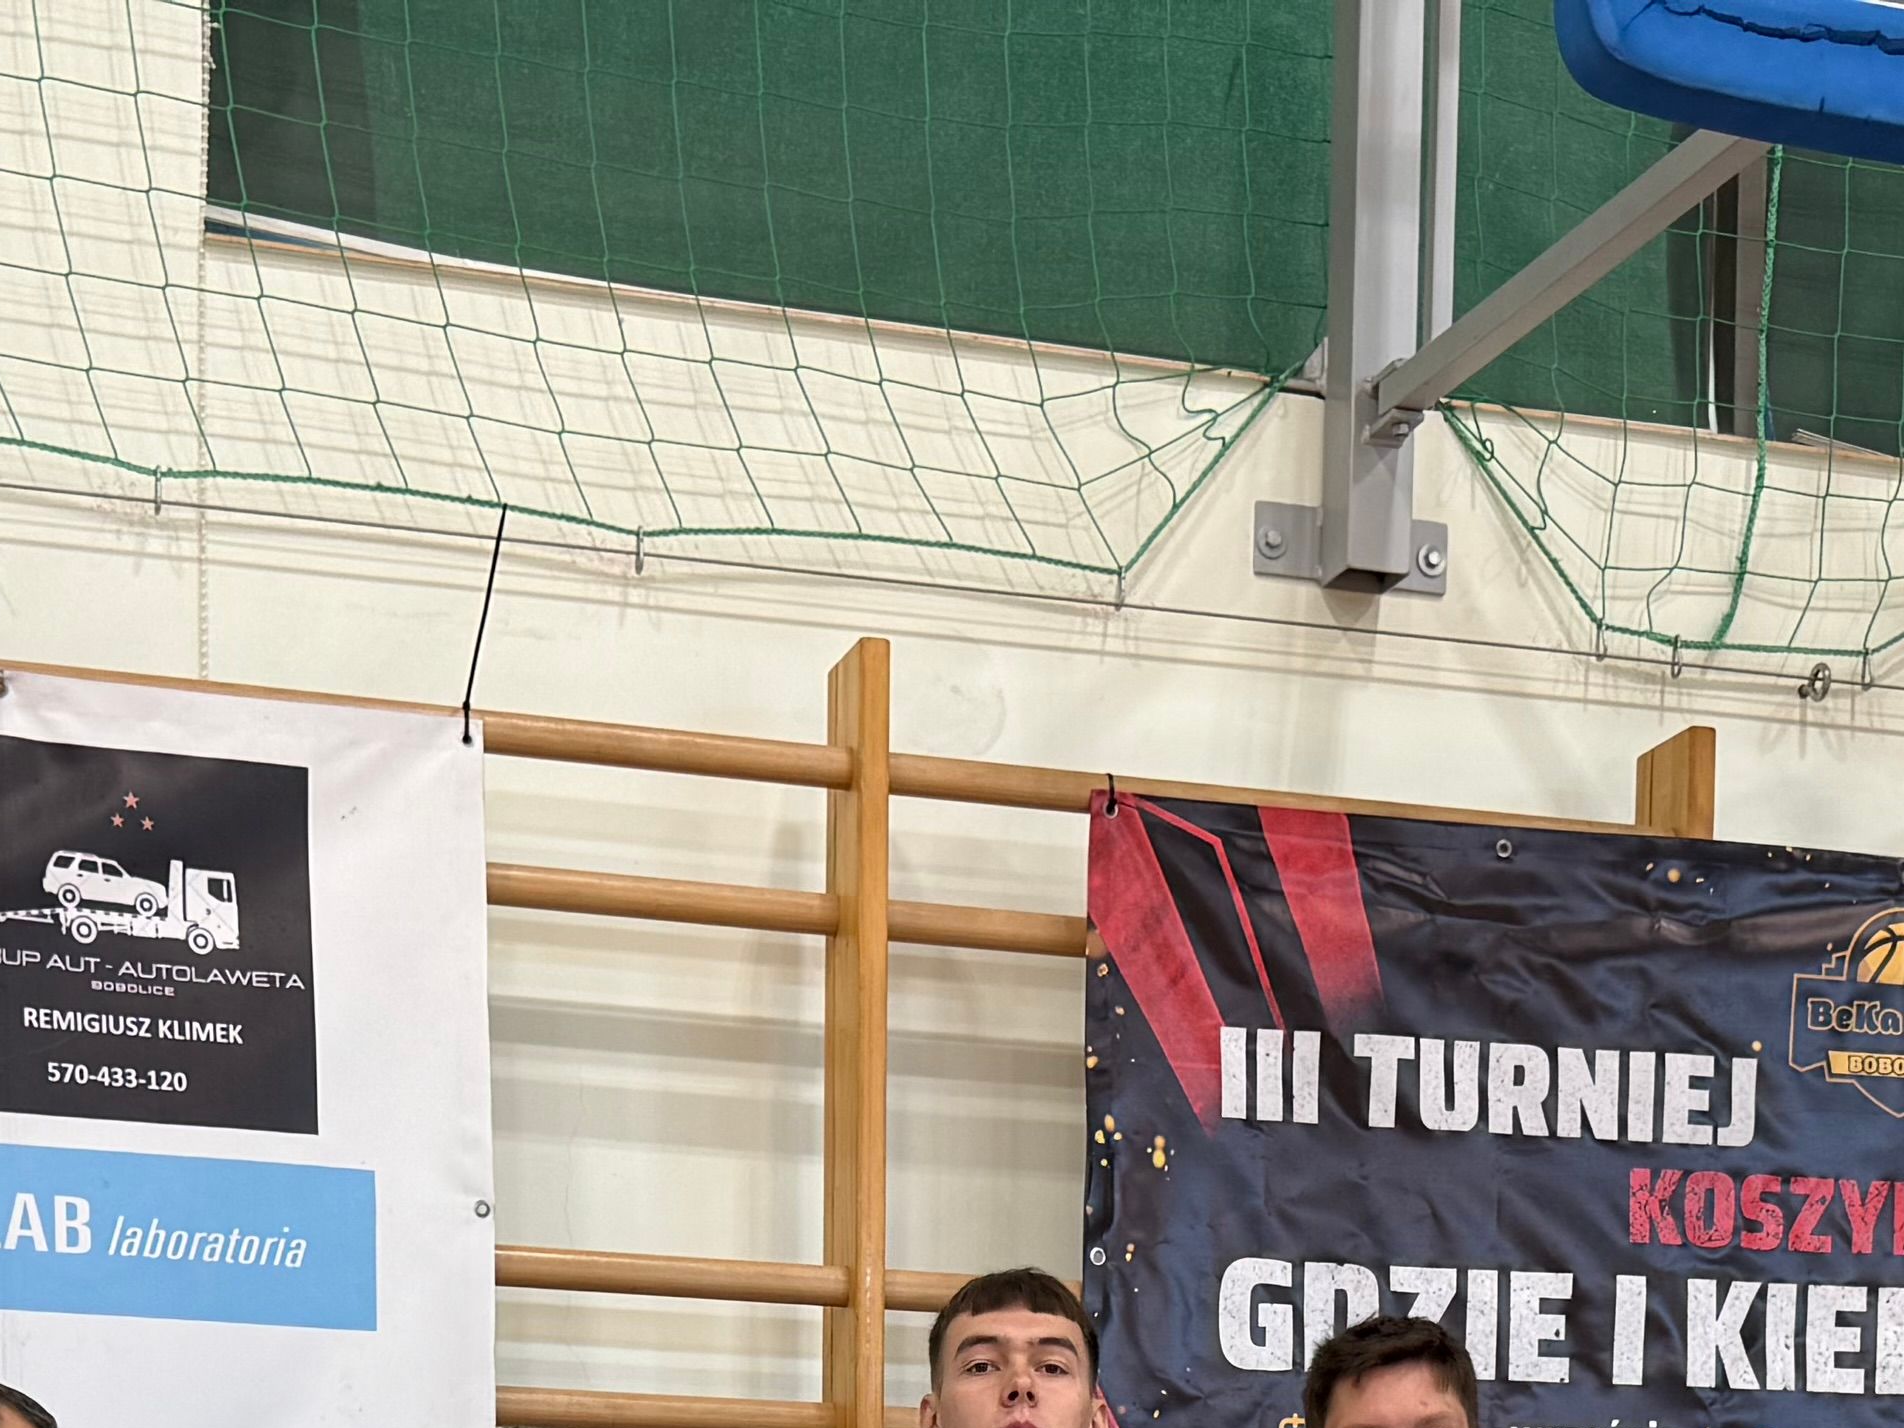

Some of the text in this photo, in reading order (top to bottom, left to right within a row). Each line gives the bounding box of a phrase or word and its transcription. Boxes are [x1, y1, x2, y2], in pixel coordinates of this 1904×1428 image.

[45, 953, 101, 974] AUT
[117, 960, 305, 990] AUTOLAWETA
[90, 980, 175, 997] BOBOLICE
[23, 1006, 244, 1045] REMIGIUSZ KLIMEK
[47, 1061, 188, 1092] 570-433-120
[1219, 1023, 1758, 1147] III TURNIEJ
[108, 1215, 307, 1268] laboratoria
[1612, 1274, 1647, 1386] I
